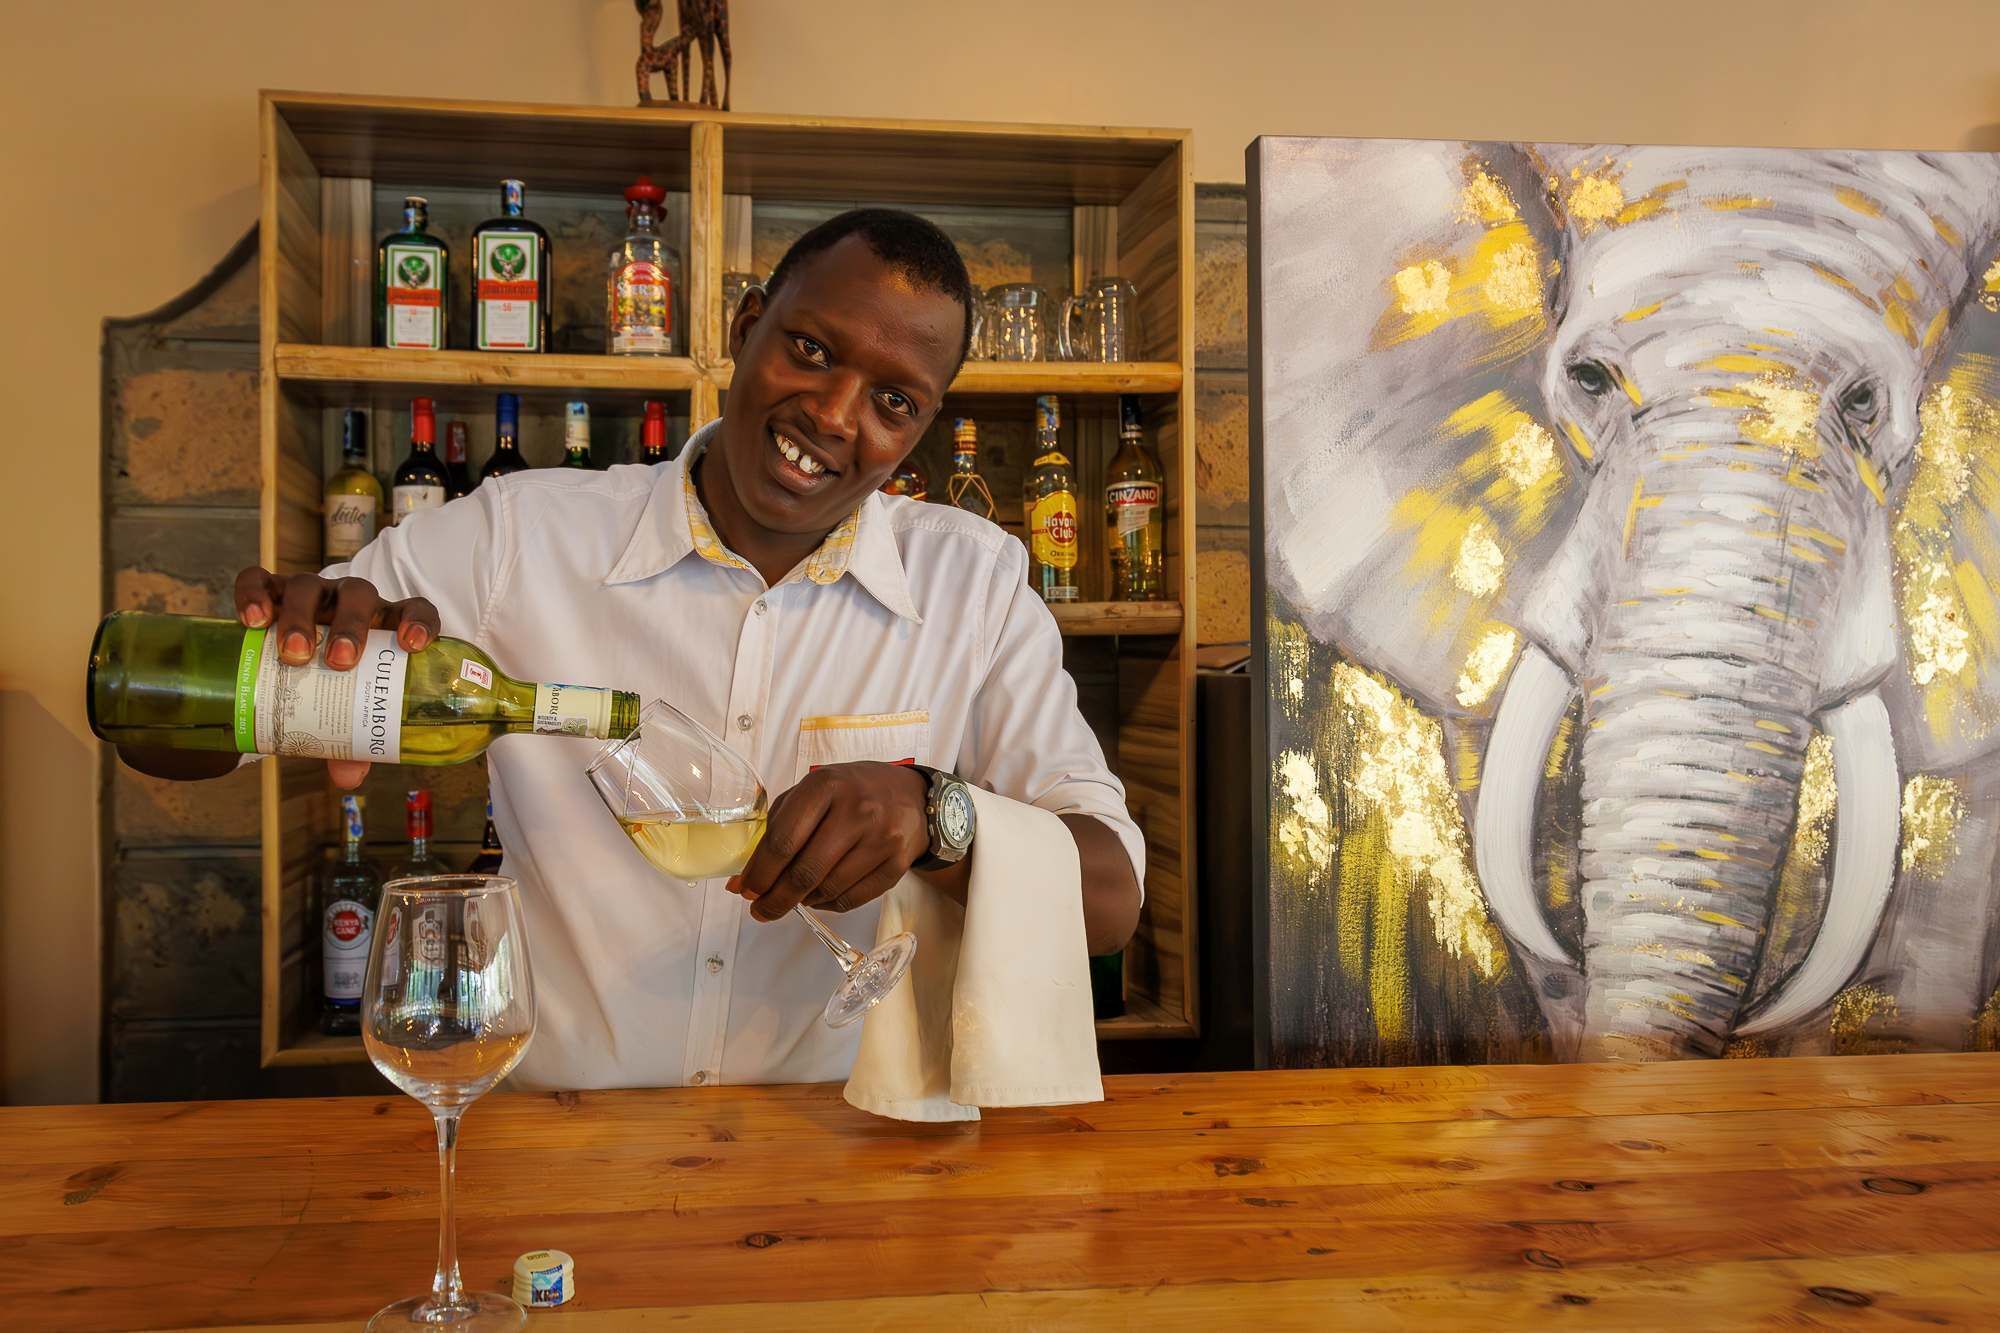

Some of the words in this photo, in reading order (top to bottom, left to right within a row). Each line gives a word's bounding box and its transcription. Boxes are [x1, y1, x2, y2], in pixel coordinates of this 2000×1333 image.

[1109, 488, 1156, 502] CINZANO
[1043, 515, 1075, 528] Havan
[1052, 527, 1073, 538] Club
[369, 649, 396, 755] CULEMBORG
